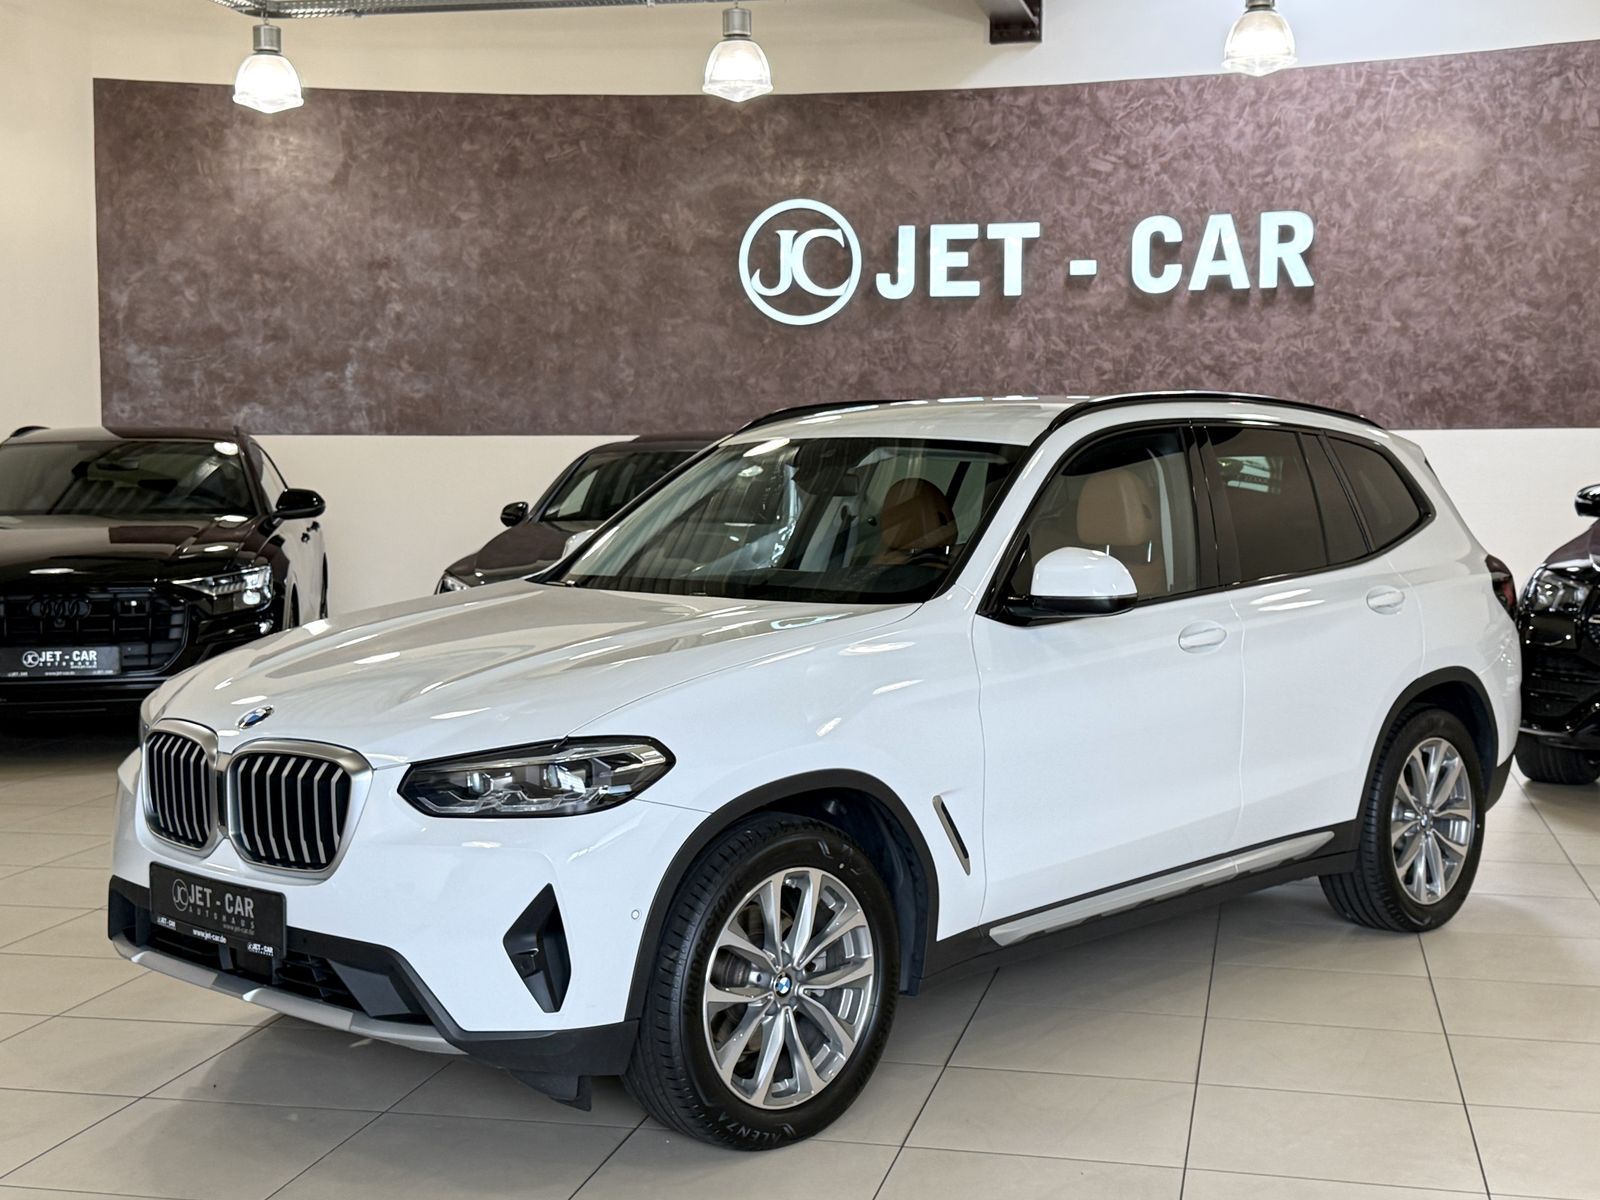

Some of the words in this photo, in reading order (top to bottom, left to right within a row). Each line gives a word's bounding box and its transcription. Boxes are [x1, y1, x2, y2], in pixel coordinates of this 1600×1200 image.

[875, 221, 1041, 300] JET
[1130, 210, 1316, 295] CAR
[39, 650, 63, 662] JET
[72, 650, 97, 661] CAR
[188, 883, 213, 908] JET
[224, 892, 255, 919] CAR
